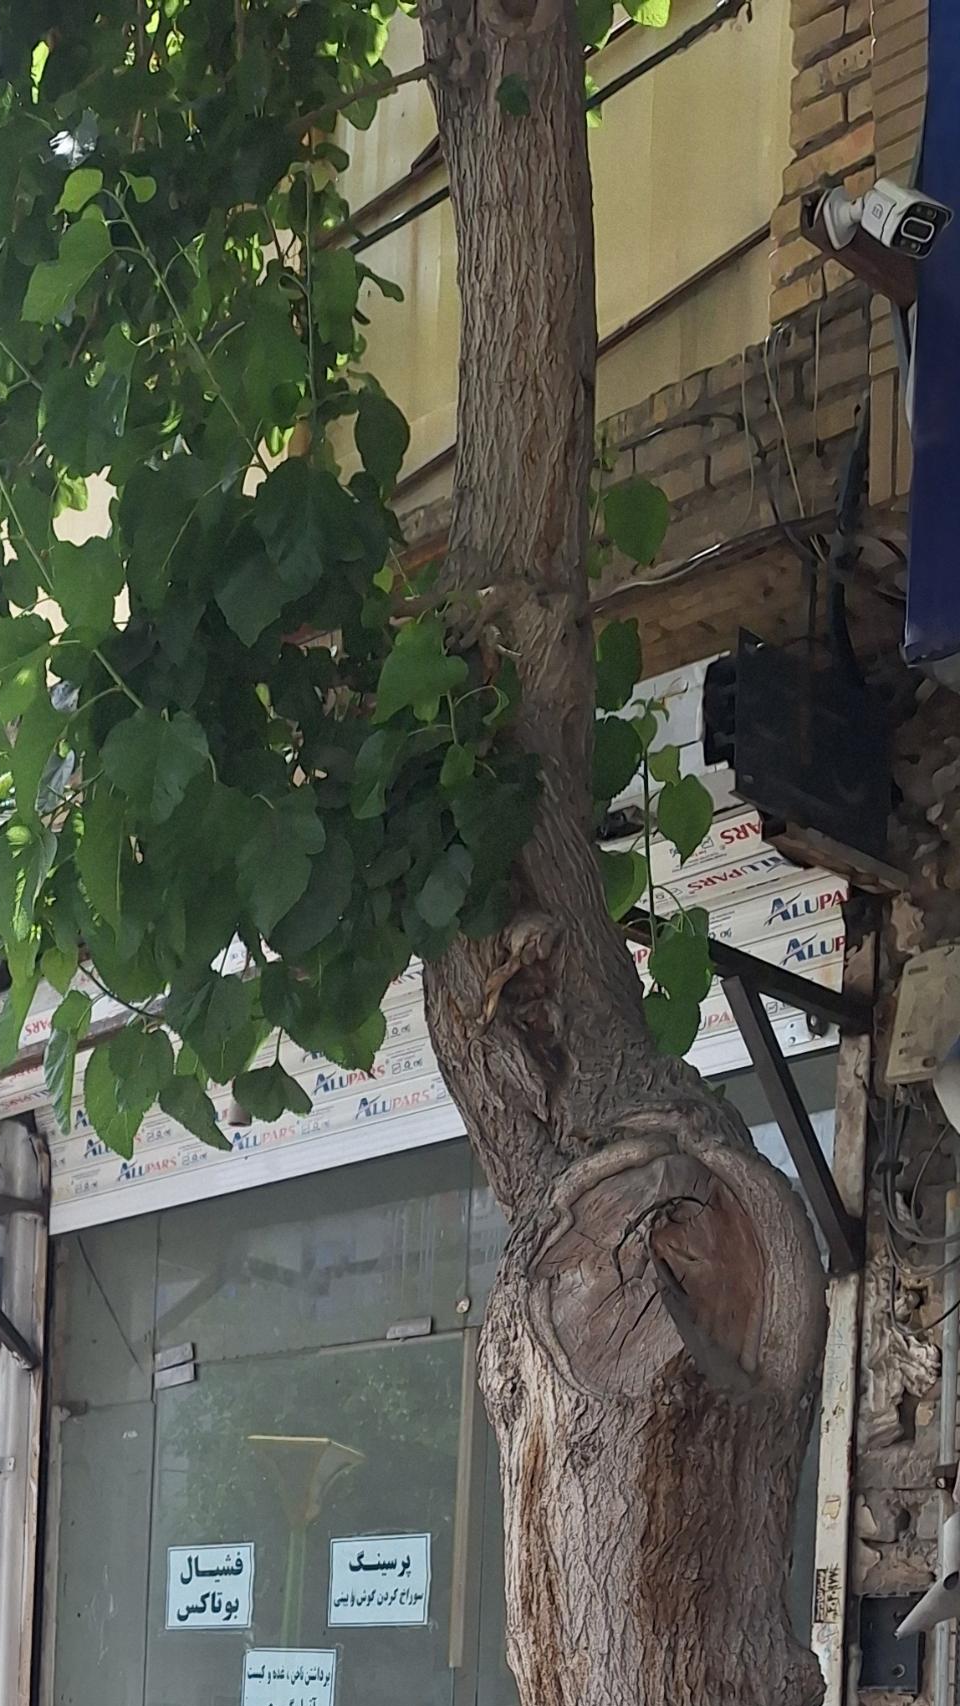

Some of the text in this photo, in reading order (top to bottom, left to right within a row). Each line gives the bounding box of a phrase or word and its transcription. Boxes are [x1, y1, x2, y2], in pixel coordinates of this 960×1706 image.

[764, 890, 848, 926] ALUPA
[779, 933, 845, 966] ALUP
[355, 1089, 429, 1120] ALUPARS
[233, 1126, 296, 1150] ALUPARS
[117, 1156, 177, 1182] ALUPARS
[180, 1551, 243, 1585] فشیال
[349, 1550, 411, 1577] پرسینگ
[177, 1591, 239, 1621] بوتاکس
[377, 1588, 398, 1606] کردن
[399, 1587, 424, 1605] سوراخ
